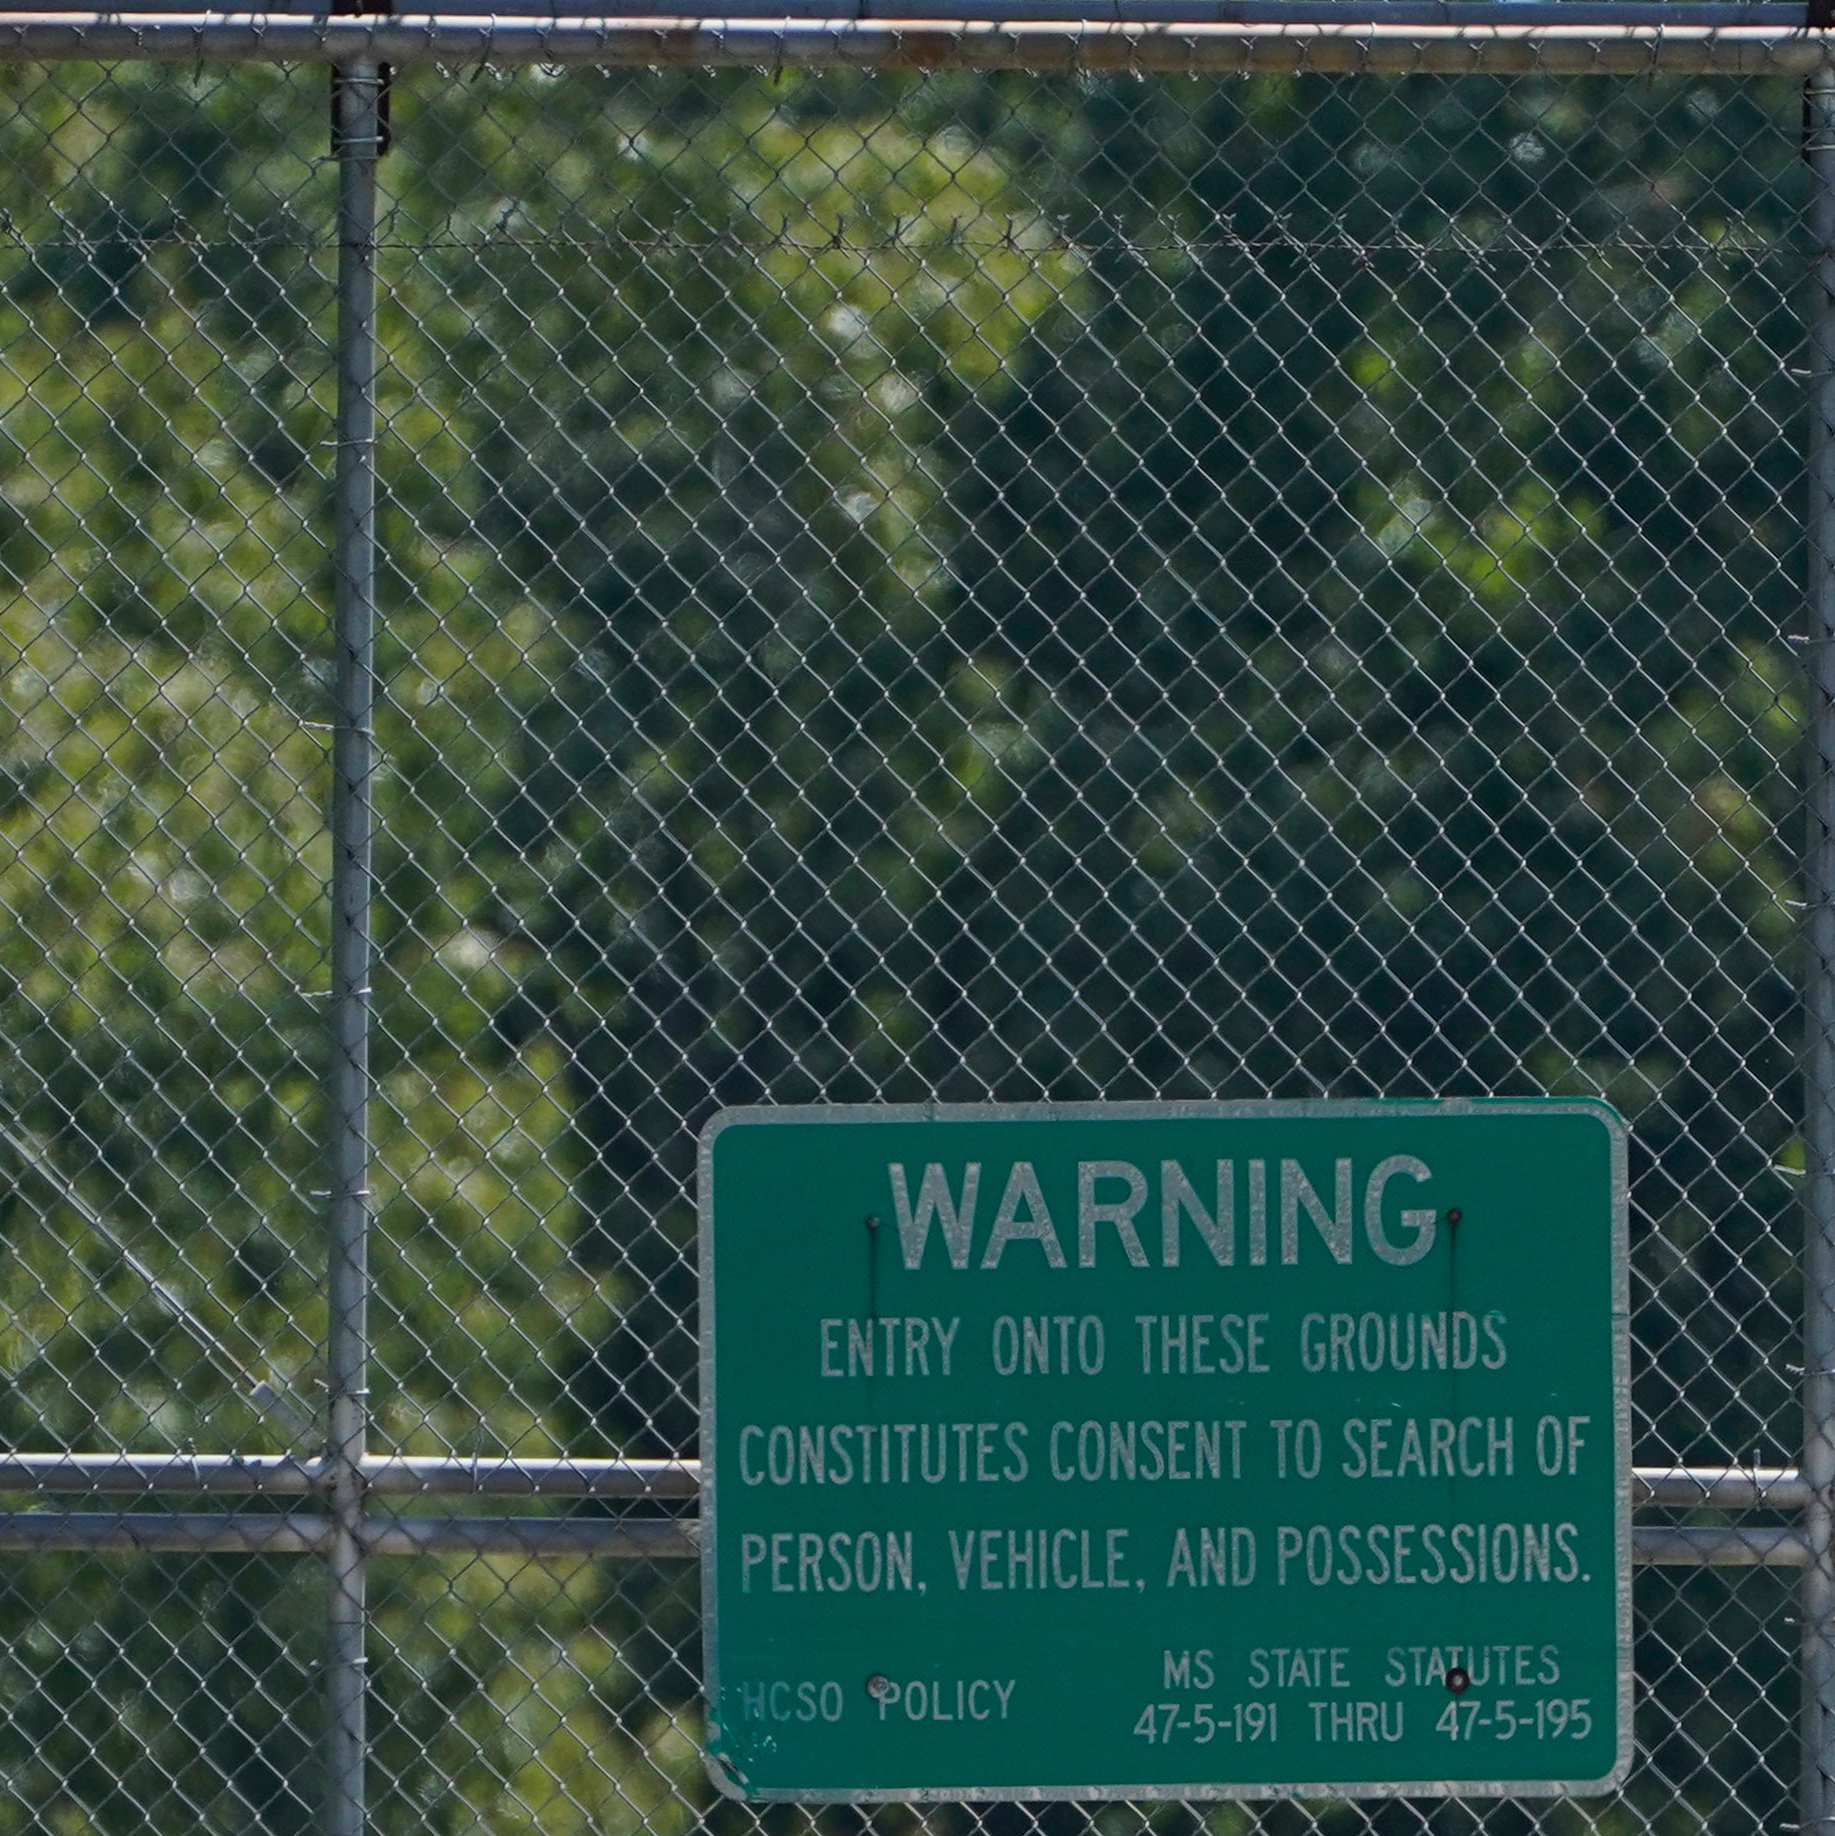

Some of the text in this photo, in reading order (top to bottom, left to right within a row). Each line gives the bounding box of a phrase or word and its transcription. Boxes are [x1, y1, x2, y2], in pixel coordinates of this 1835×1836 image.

[888, 1154, 1437, 1270] WARNING
[820, 1310, 1507, 1377] ENTRY ONTO THESE GROUNDS
[739, 1415, 1590, 1486] CONSTITUTES CONSENT TO SEARCH OF
[742, 1523, 1592, 1595] PERSON, VEHICLE, AND POSSESSIONS.
[742, 1679, 1015, 1722] HCSO POLICY
[1163, 1644, 1560, 1690] MS STATE STATUTES
[1133, 1698, 1592, 1744] 47-5-191 THRU 47-5-195
